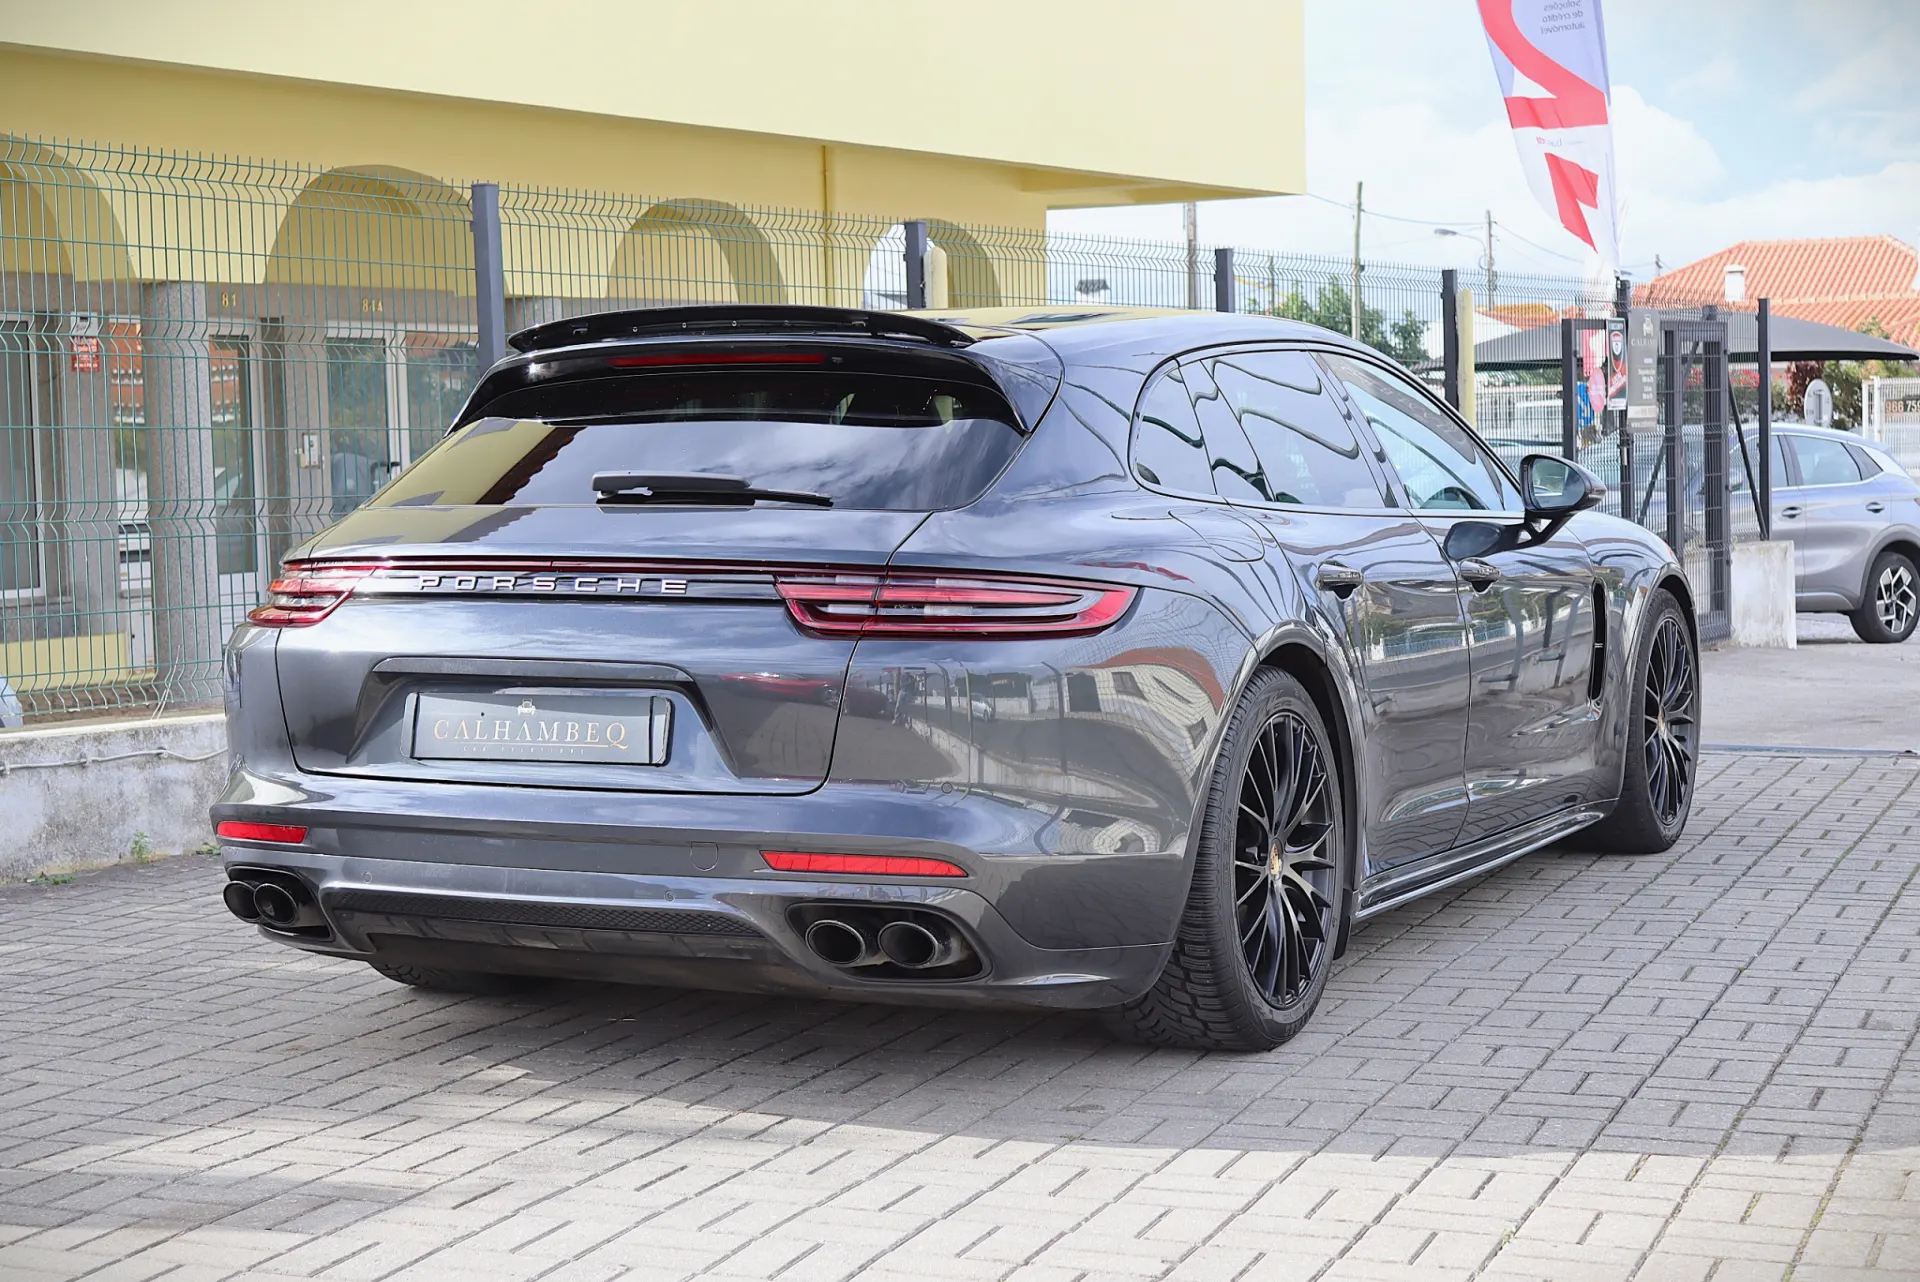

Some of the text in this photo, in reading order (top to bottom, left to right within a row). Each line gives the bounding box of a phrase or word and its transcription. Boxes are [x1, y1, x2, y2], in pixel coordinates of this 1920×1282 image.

[222, 292, 236, 307] 81
[1886, 400, 1904, 412] 966
[419, 575, 688, 594] PORSCHE
[433, 718, 629, 750] CALHAMBEQ
